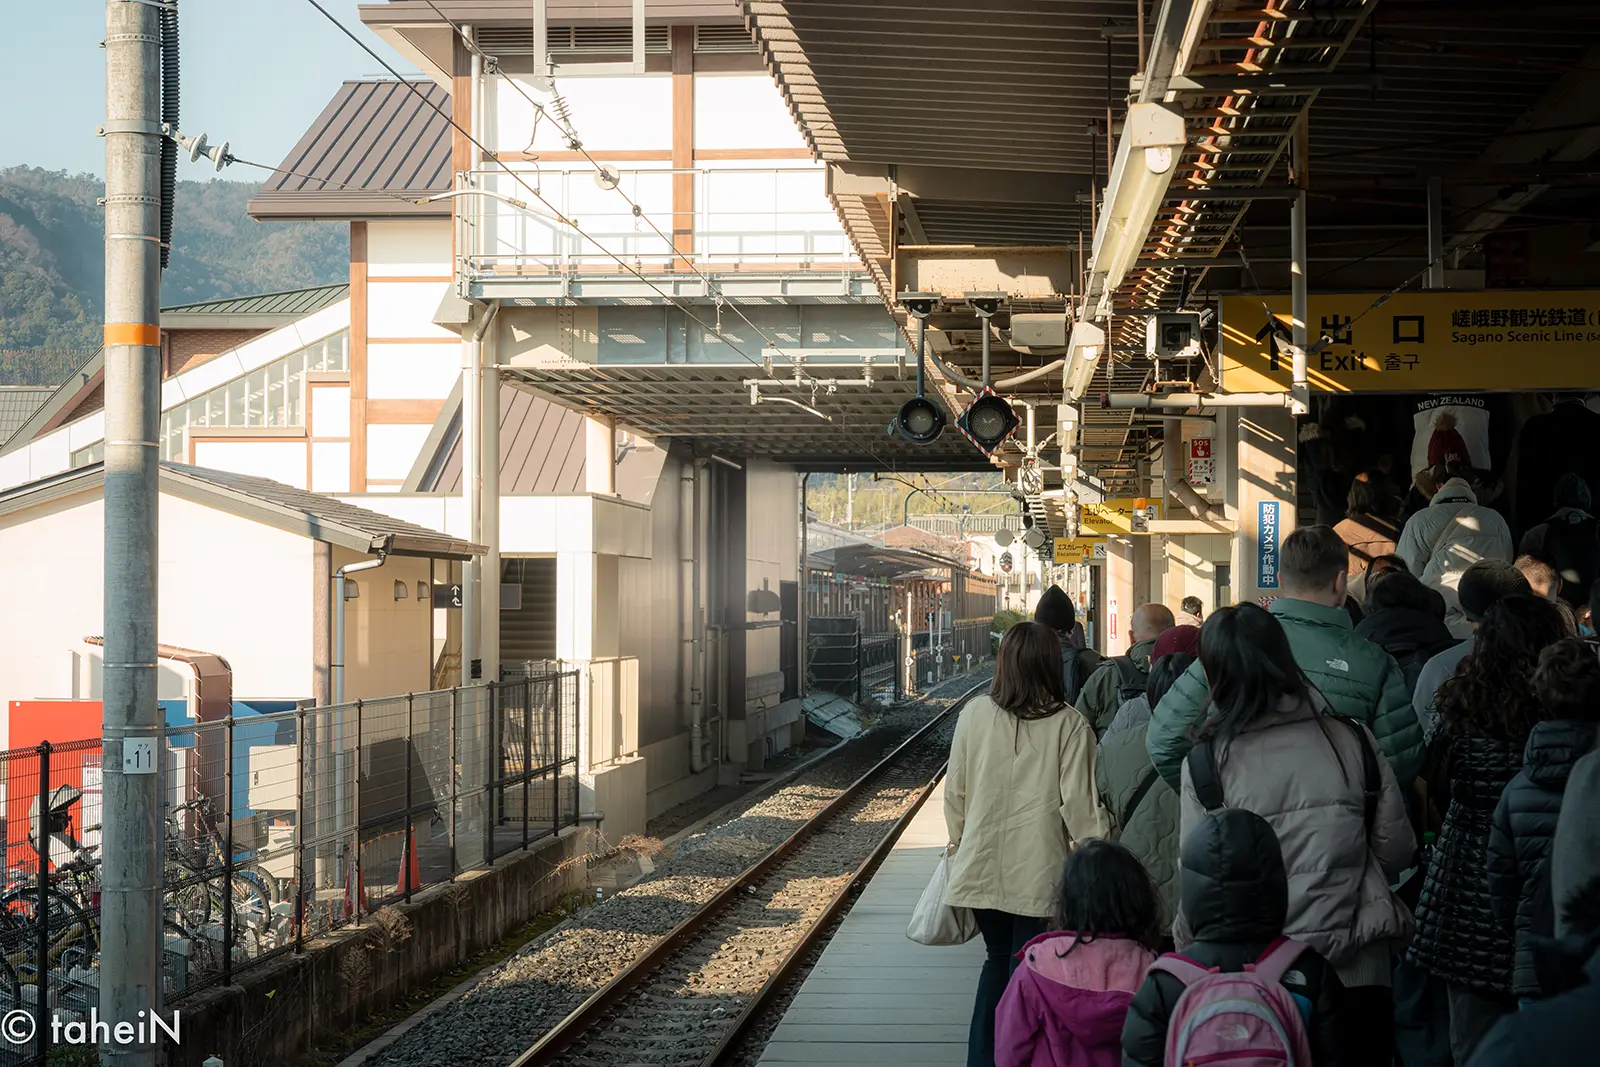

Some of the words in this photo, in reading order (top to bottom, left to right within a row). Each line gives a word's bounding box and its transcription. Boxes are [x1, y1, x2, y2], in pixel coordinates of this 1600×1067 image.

[1452, 308, 1600, 327] 嵯峨野観光鉄道(
[1321, 314, 1424, 345] 出口
[1452, 331, 1503, 345] Sagano
[1508, 330, 1550, 342] Scenic
[1554, 330, 1583, 341] Line
[1320, 350, 1368, 371] Exit
[1384, 353, 1420, 370] 출구
[1417, 398, 1439, 411] NEW
[1440, 396, 1485, 407] ZEALAND
[1057, 543, 1093, 551] エスカレーター
[1262, 503, 1275, 585] 防犯カメラ作動中
[134, 750, 151, 768] 11
